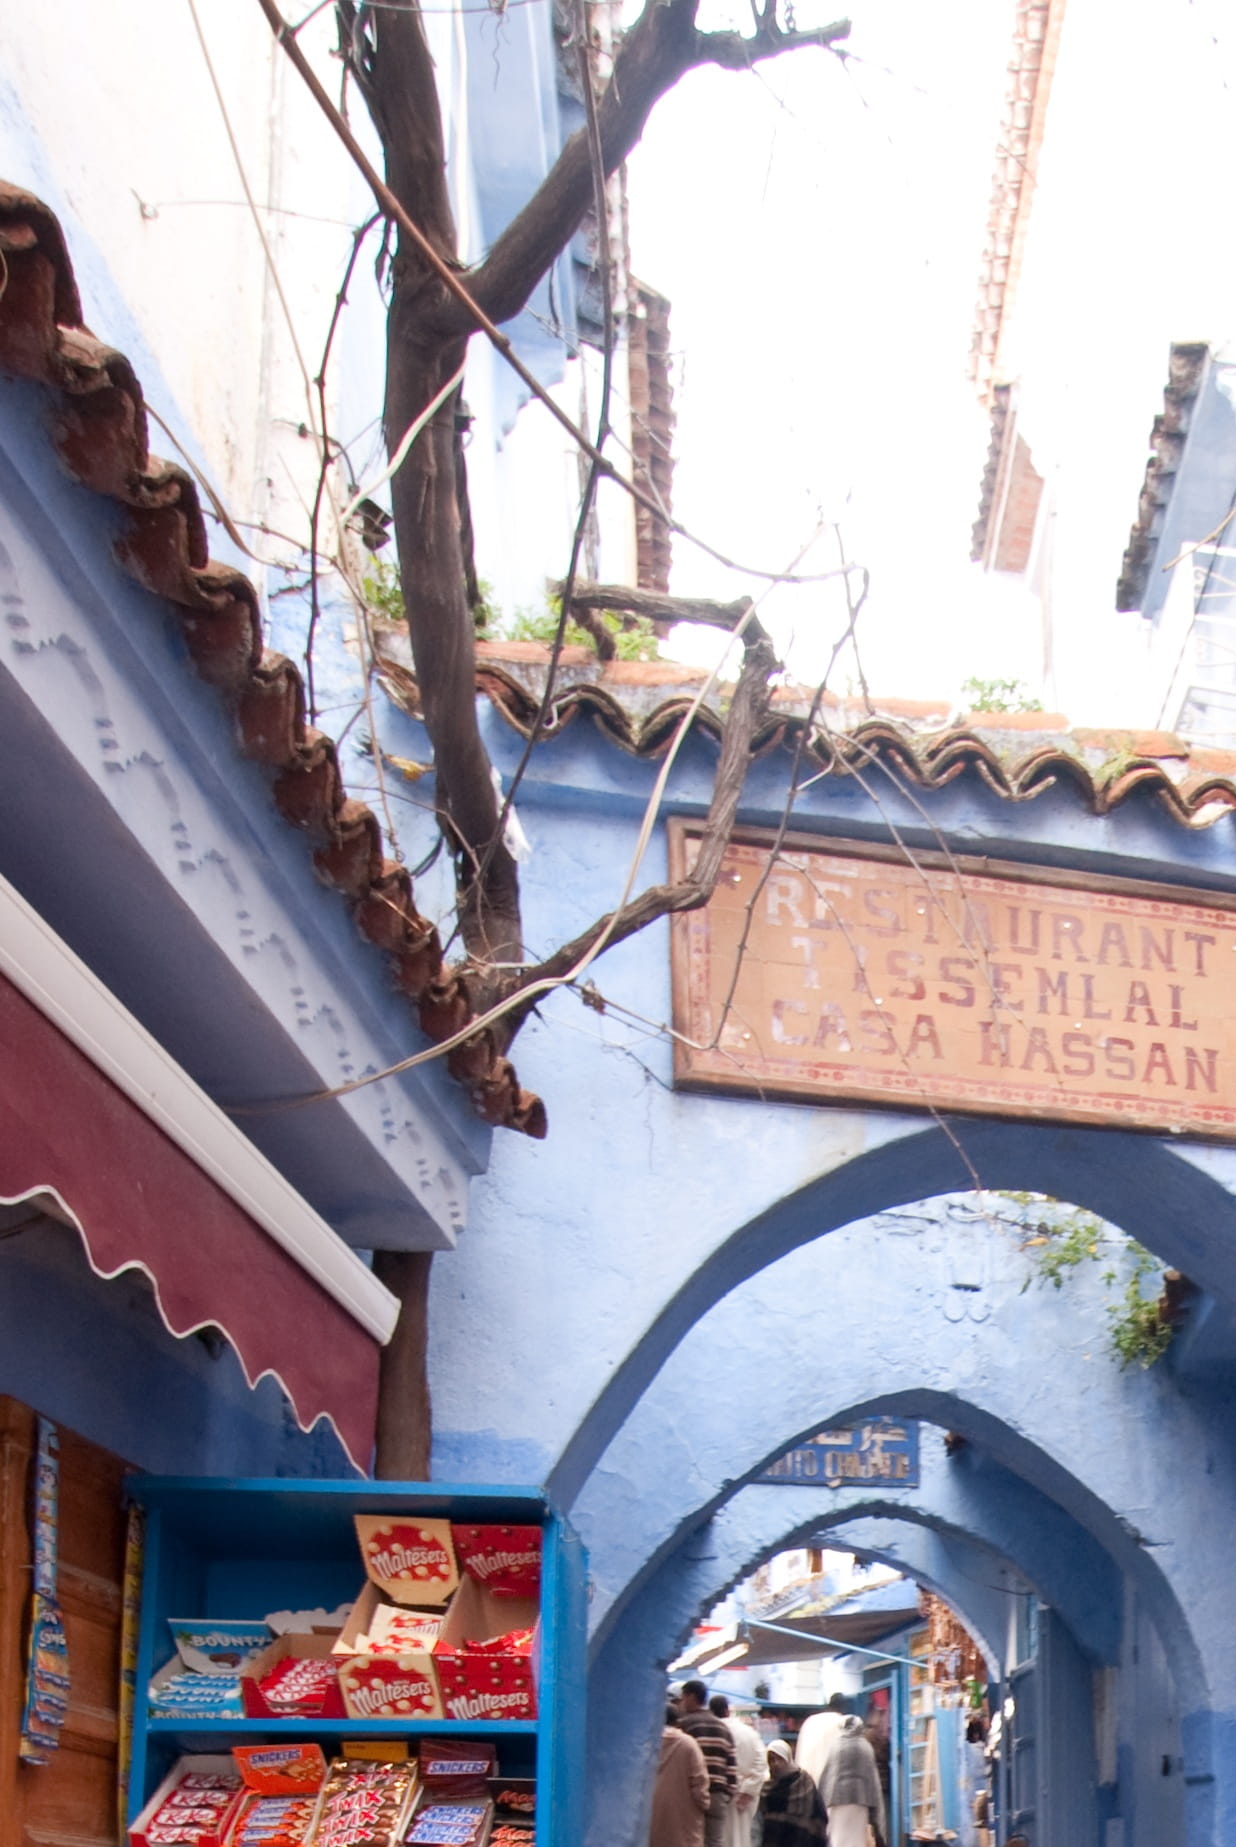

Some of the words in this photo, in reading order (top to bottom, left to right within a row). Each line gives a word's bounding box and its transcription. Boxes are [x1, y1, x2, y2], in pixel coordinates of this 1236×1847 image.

[766, 875, 1216, 977] RESTAURANT
[791, 936, 1198, 1031] TISSEMLAL
[771, 999, 945, 1060] CASA
[977, 1021, 1220, 1093] HASSAN
[371, 1550, 448, 1582] Maltesers
[191, 1635, 266, 1647] BOUNTY
[350, 1681, 431, 1717] Maltesers
[446, 1691, 529, 1720] Maltesers
[251, 1749, 302, 1765] SNICKERS
[429, 1761, 488, 1774] SNICKERS
